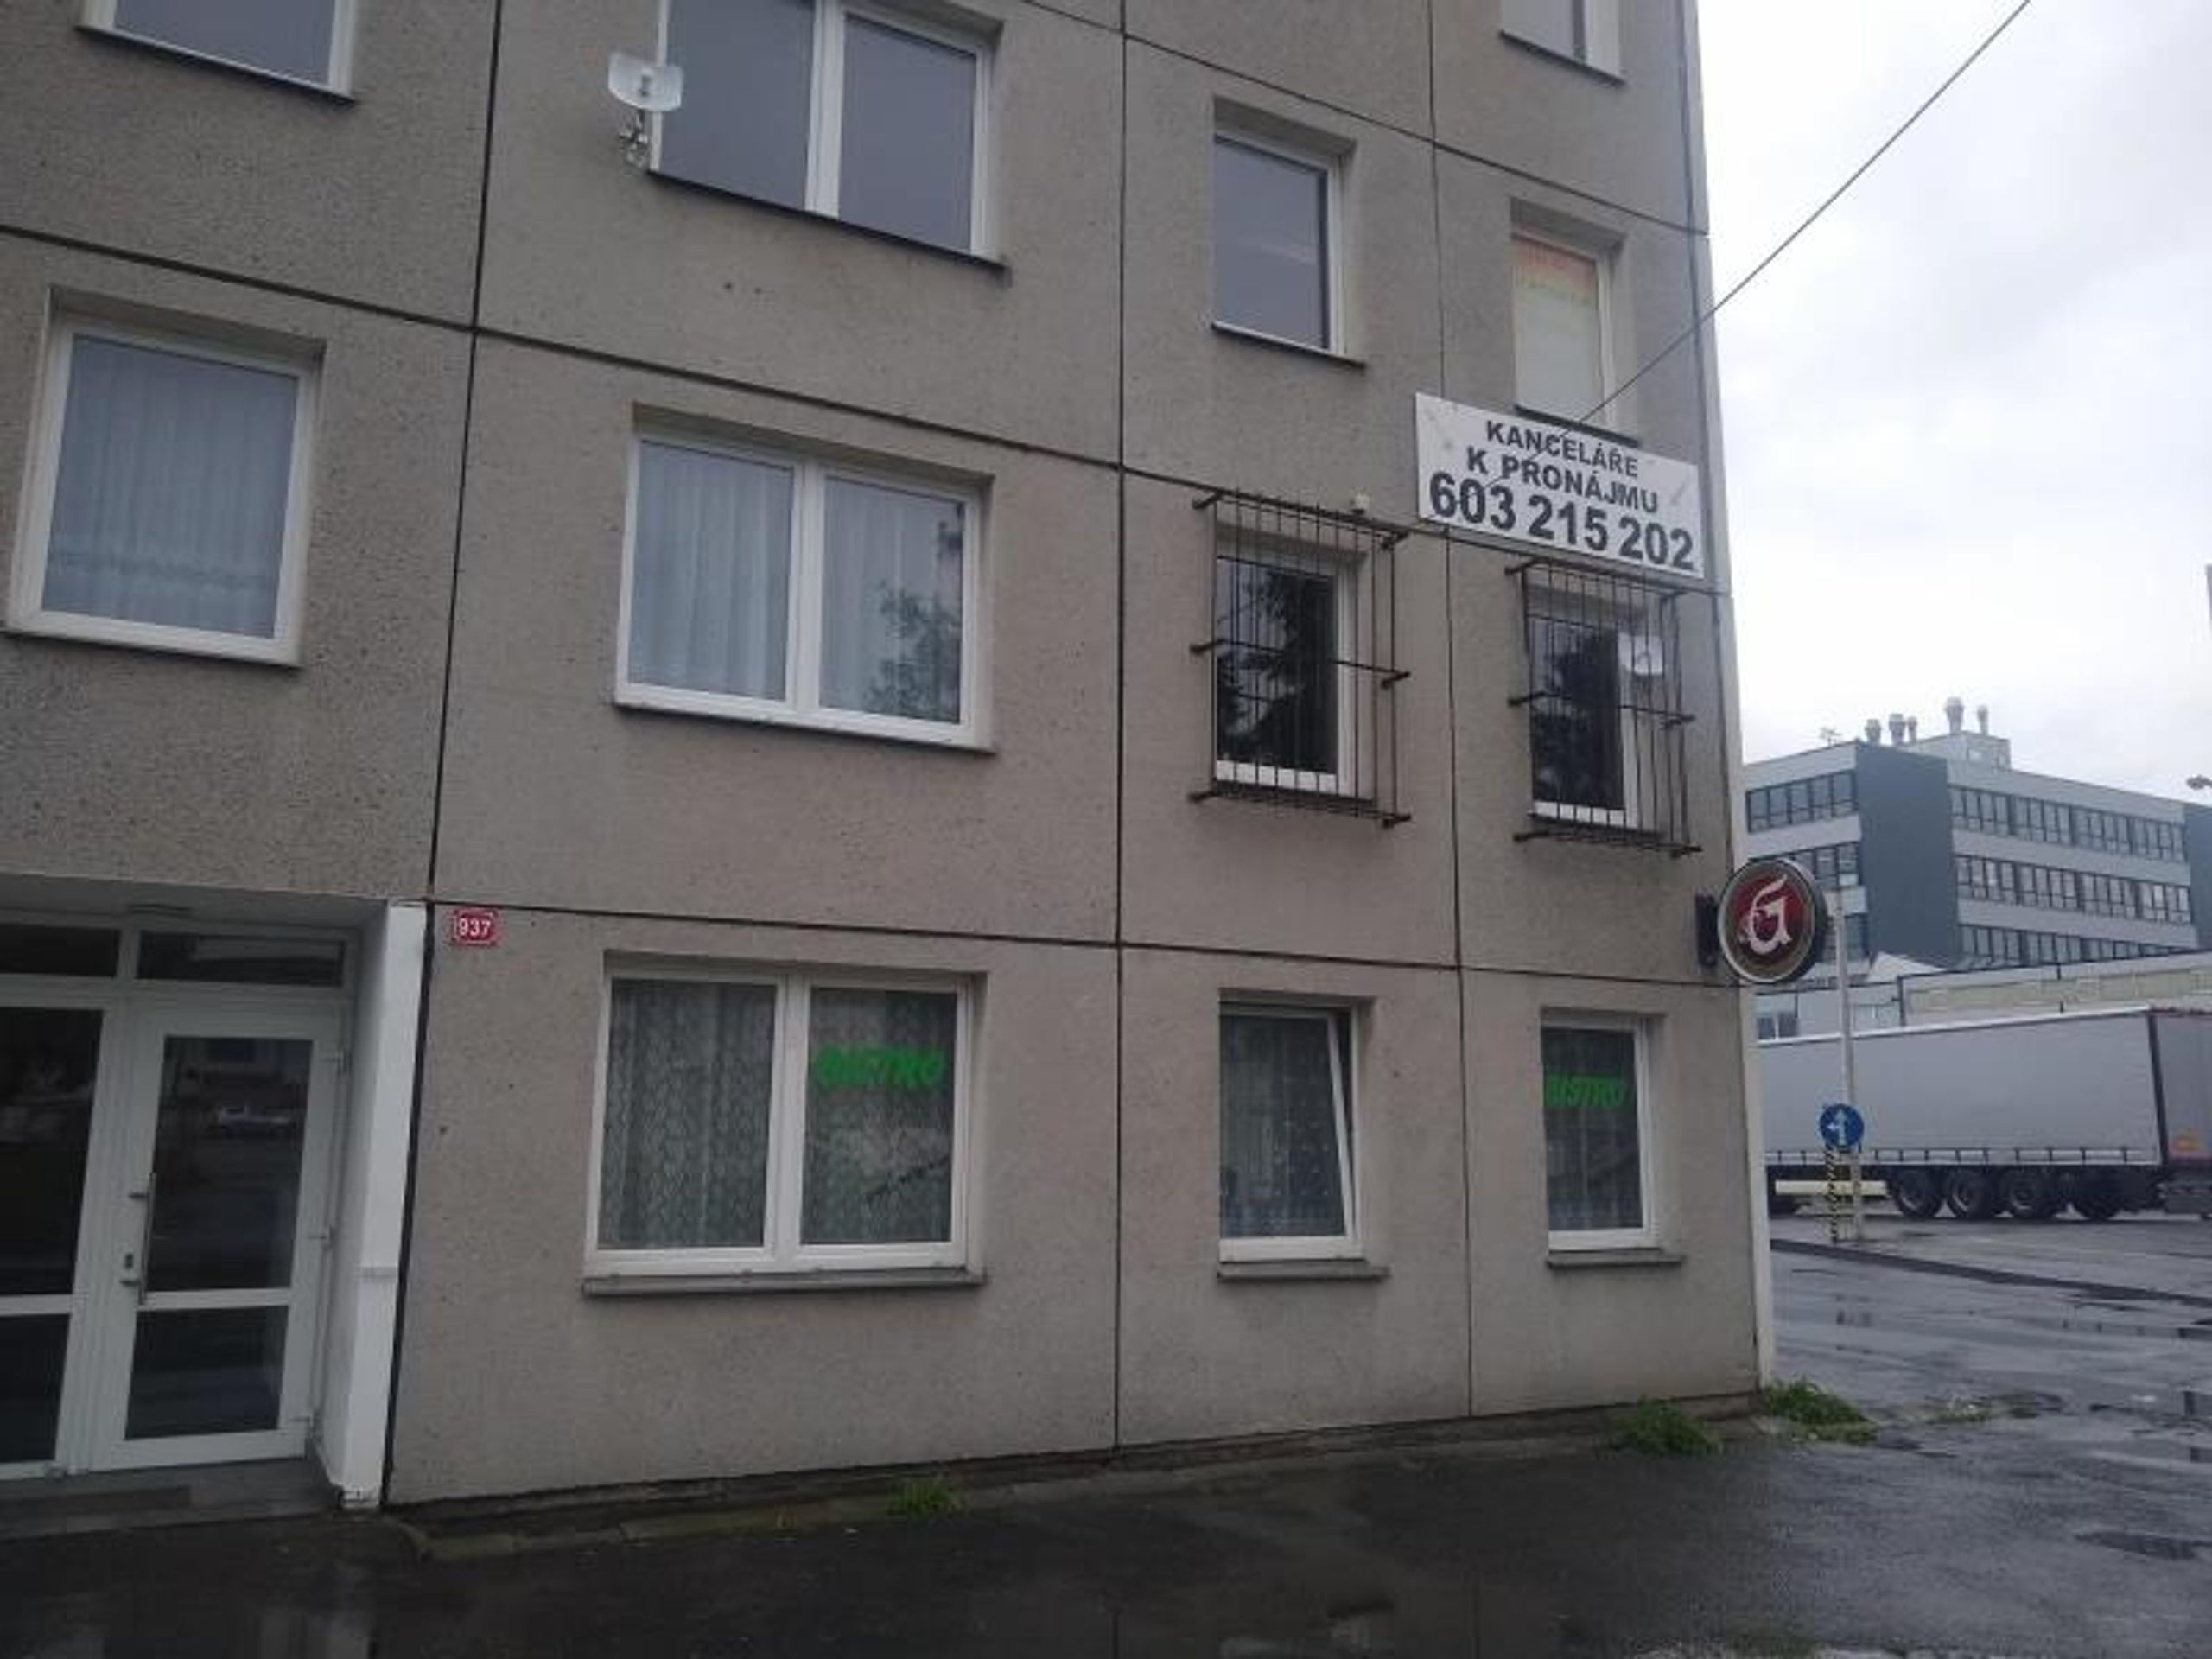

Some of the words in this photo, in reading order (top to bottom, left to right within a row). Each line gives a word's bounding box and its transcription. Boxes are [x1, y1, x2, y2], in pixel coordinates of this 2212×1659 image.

[1466, 446, 1489, 474] K
[1501, 454, 1658, 513] PRONÁJMU
[1486, 420, 1638, 477] KANCELÁŘE
[1429, 472, 1516, 531] 603
[1528, 494, 1608, 551] 215
[1618, 517, 1694, 571] 202
